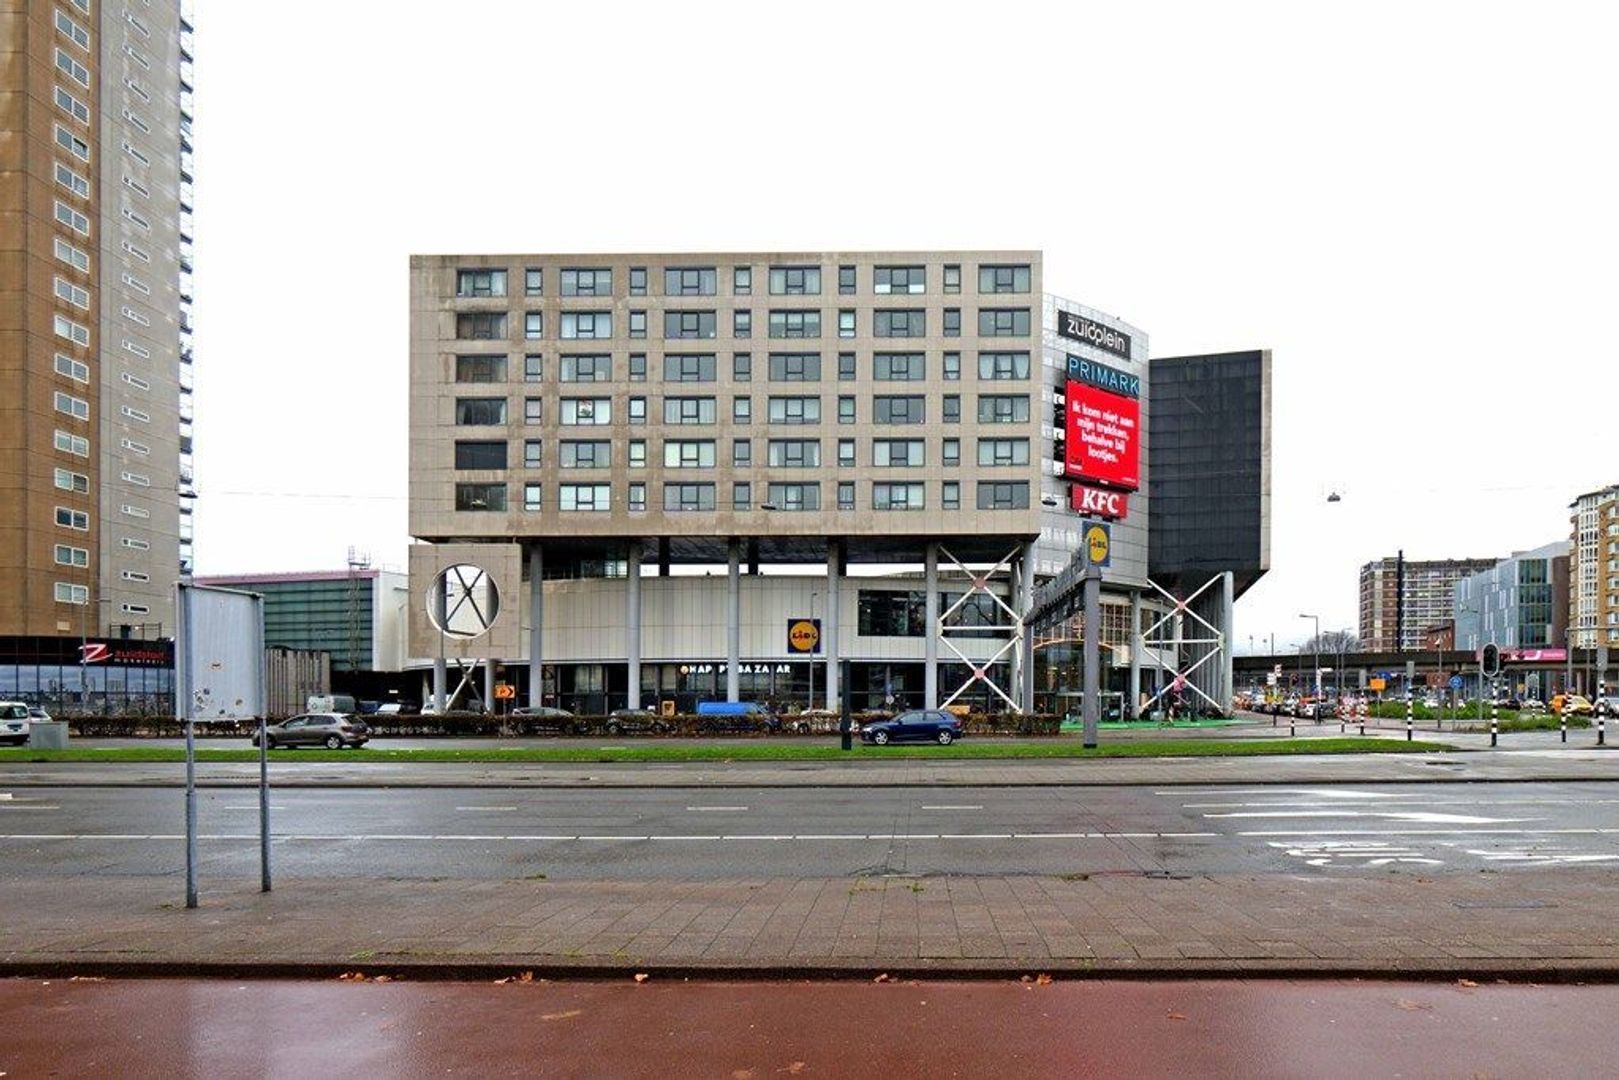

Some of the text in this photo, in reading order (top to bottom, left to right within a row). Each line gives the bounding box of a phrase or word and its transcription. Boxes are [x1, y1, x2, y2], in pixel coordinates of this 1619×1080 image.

[1067, 319, 1126, 353] zuidplein
[1069, 357, 1139, 395] PRIMARK
[1081, 429, 1126, 454] behalve bij
[1081, 488, 1120, 514] KFC
[689, 664, 729, 674] HAPP
